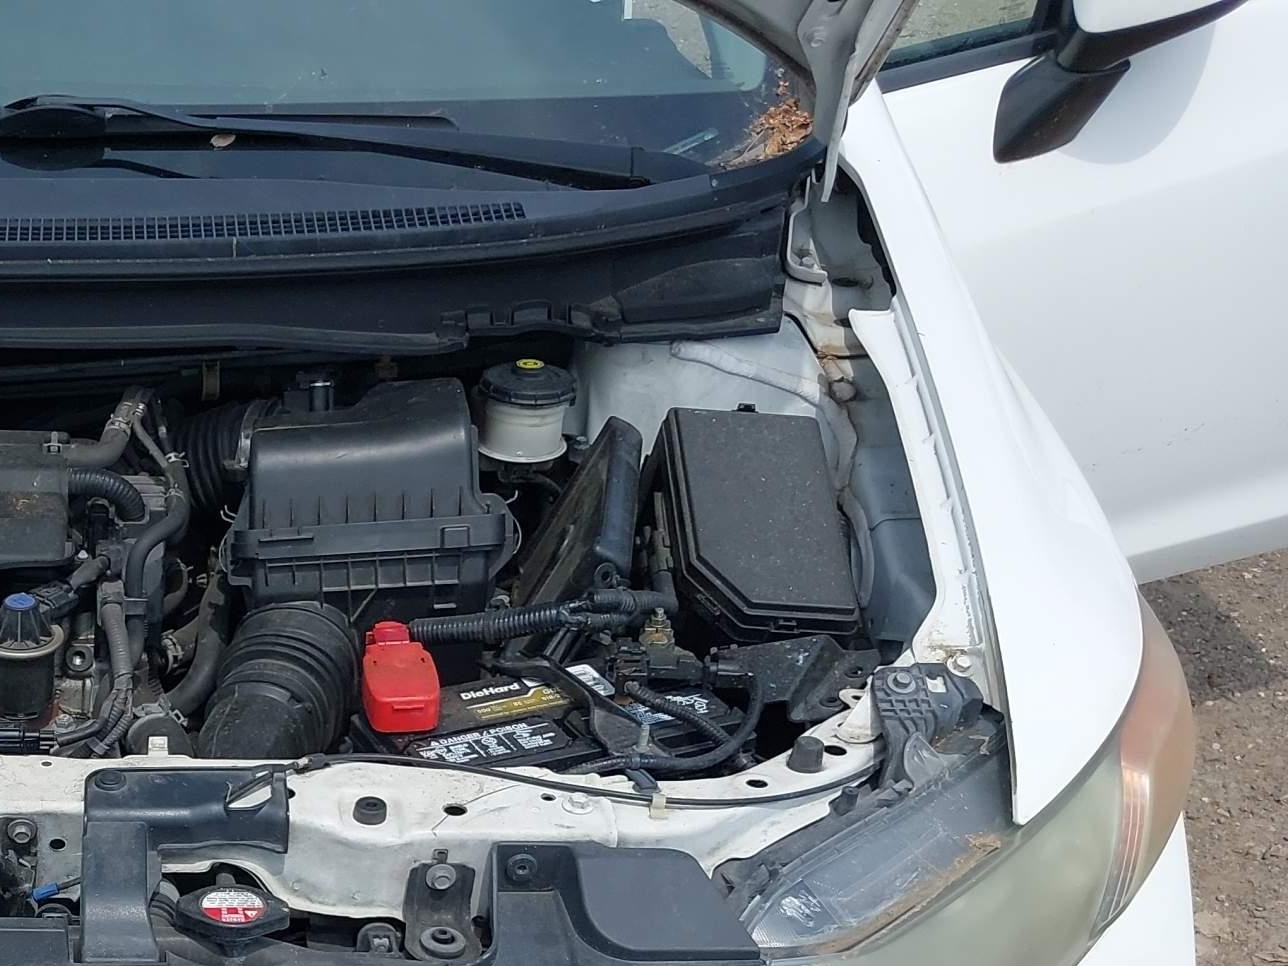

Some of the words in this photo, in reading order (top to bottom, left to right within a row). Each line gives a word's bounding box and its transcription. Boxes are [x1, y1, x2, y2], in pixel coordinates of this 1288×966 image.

[460, 682, 521, 701] DieHard
[439, 732, 481, 746] DANGER
[489, 722, 529, 735] POISON
